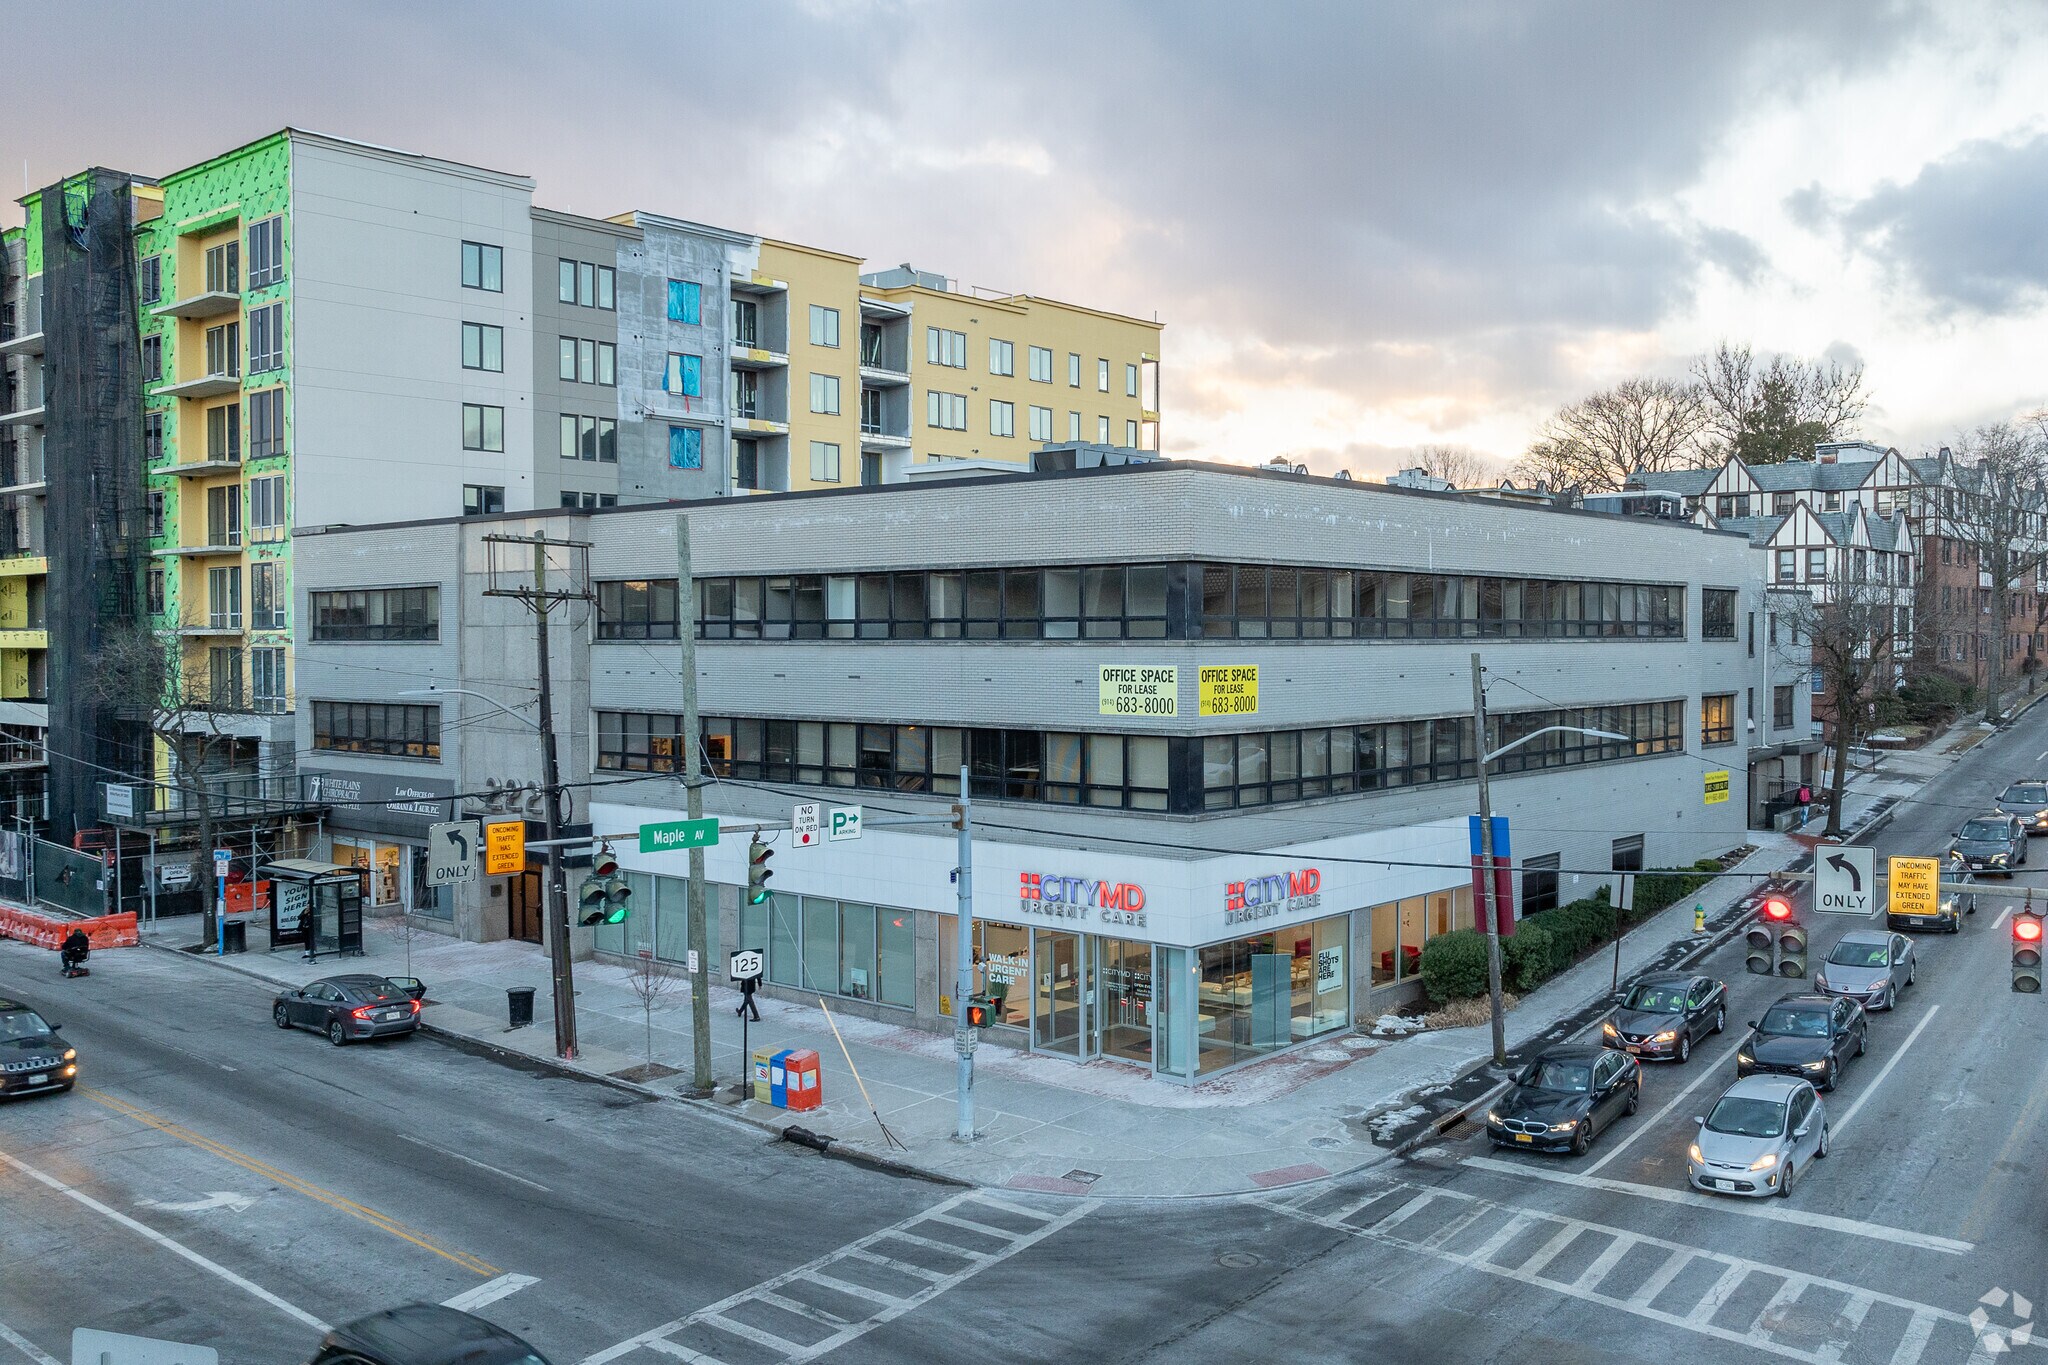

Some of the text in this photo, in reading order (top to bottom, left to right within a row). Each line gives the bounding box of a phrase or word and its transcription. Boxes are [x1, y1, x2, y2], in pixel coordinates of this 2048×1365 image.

[1103, 669, 1174, 683] OFFICE SPACE
[1201, 668, 1256, 683] OFFICE SPACE
[1118, 684, 1157, 695] FOR LEASE
[1214, 683, 1244, 695] FOR LEASE
[1116, 696, 1174, 714] 683-8000
[1212, 695, 1256, 713] 683-8000
[324, 778, 361, 791] WHITE PLAINS
[323, 788, 361, 800] CHIROPRACTIC
[407, 788, 428, 798] OFFICES
[801, 806, 813, 815] NO
[799, 816, 815, 824] TURN
[492, 826, 519, 834] ONCOMING
[795, 824, 818, 833] ON RED
[496, 834, 515, 842] TRAFFIC
[653, 829, 705, 847] Maple AV
[492, 853, 519, 861] EXTENDED
[497, 862, 515, 870] GREEN
[1896, 861, 1932, 870] ONCOMING
[436, 865, 470, 880] ONLY
[1901, 872, 1927, 880] TRAFFIC
[283, 885, 309, 897] YOUR
[1243, 868, 1321, 907] CITYMD
[1913, 882, 1929, 890] HAVE
[285, 893, 308, 905] SIGN
[1040, 874, 1146, 912] CITYMD
[1895, 891, 1931, 900] EXTENDED
[1823, 894, 1866, 909] ONLY
[1020, 900, 1147, 927] URGENT CARE
[1225, 894, 1321, 926] URGENT CARE
[988, 953, 1029, 967] WALK-IN
[1318, 956, 1339, 966] SHOTS
[1319, 951, 1330, 960] FLU
[735, 957, 759, 973] 125
[988, 963, 1028, 977] URGENT
[1318, 964, 1331, 973] ARE
[989, 973, 1015, 985] CARE
[1318, 971, 1335, 980] HERE
